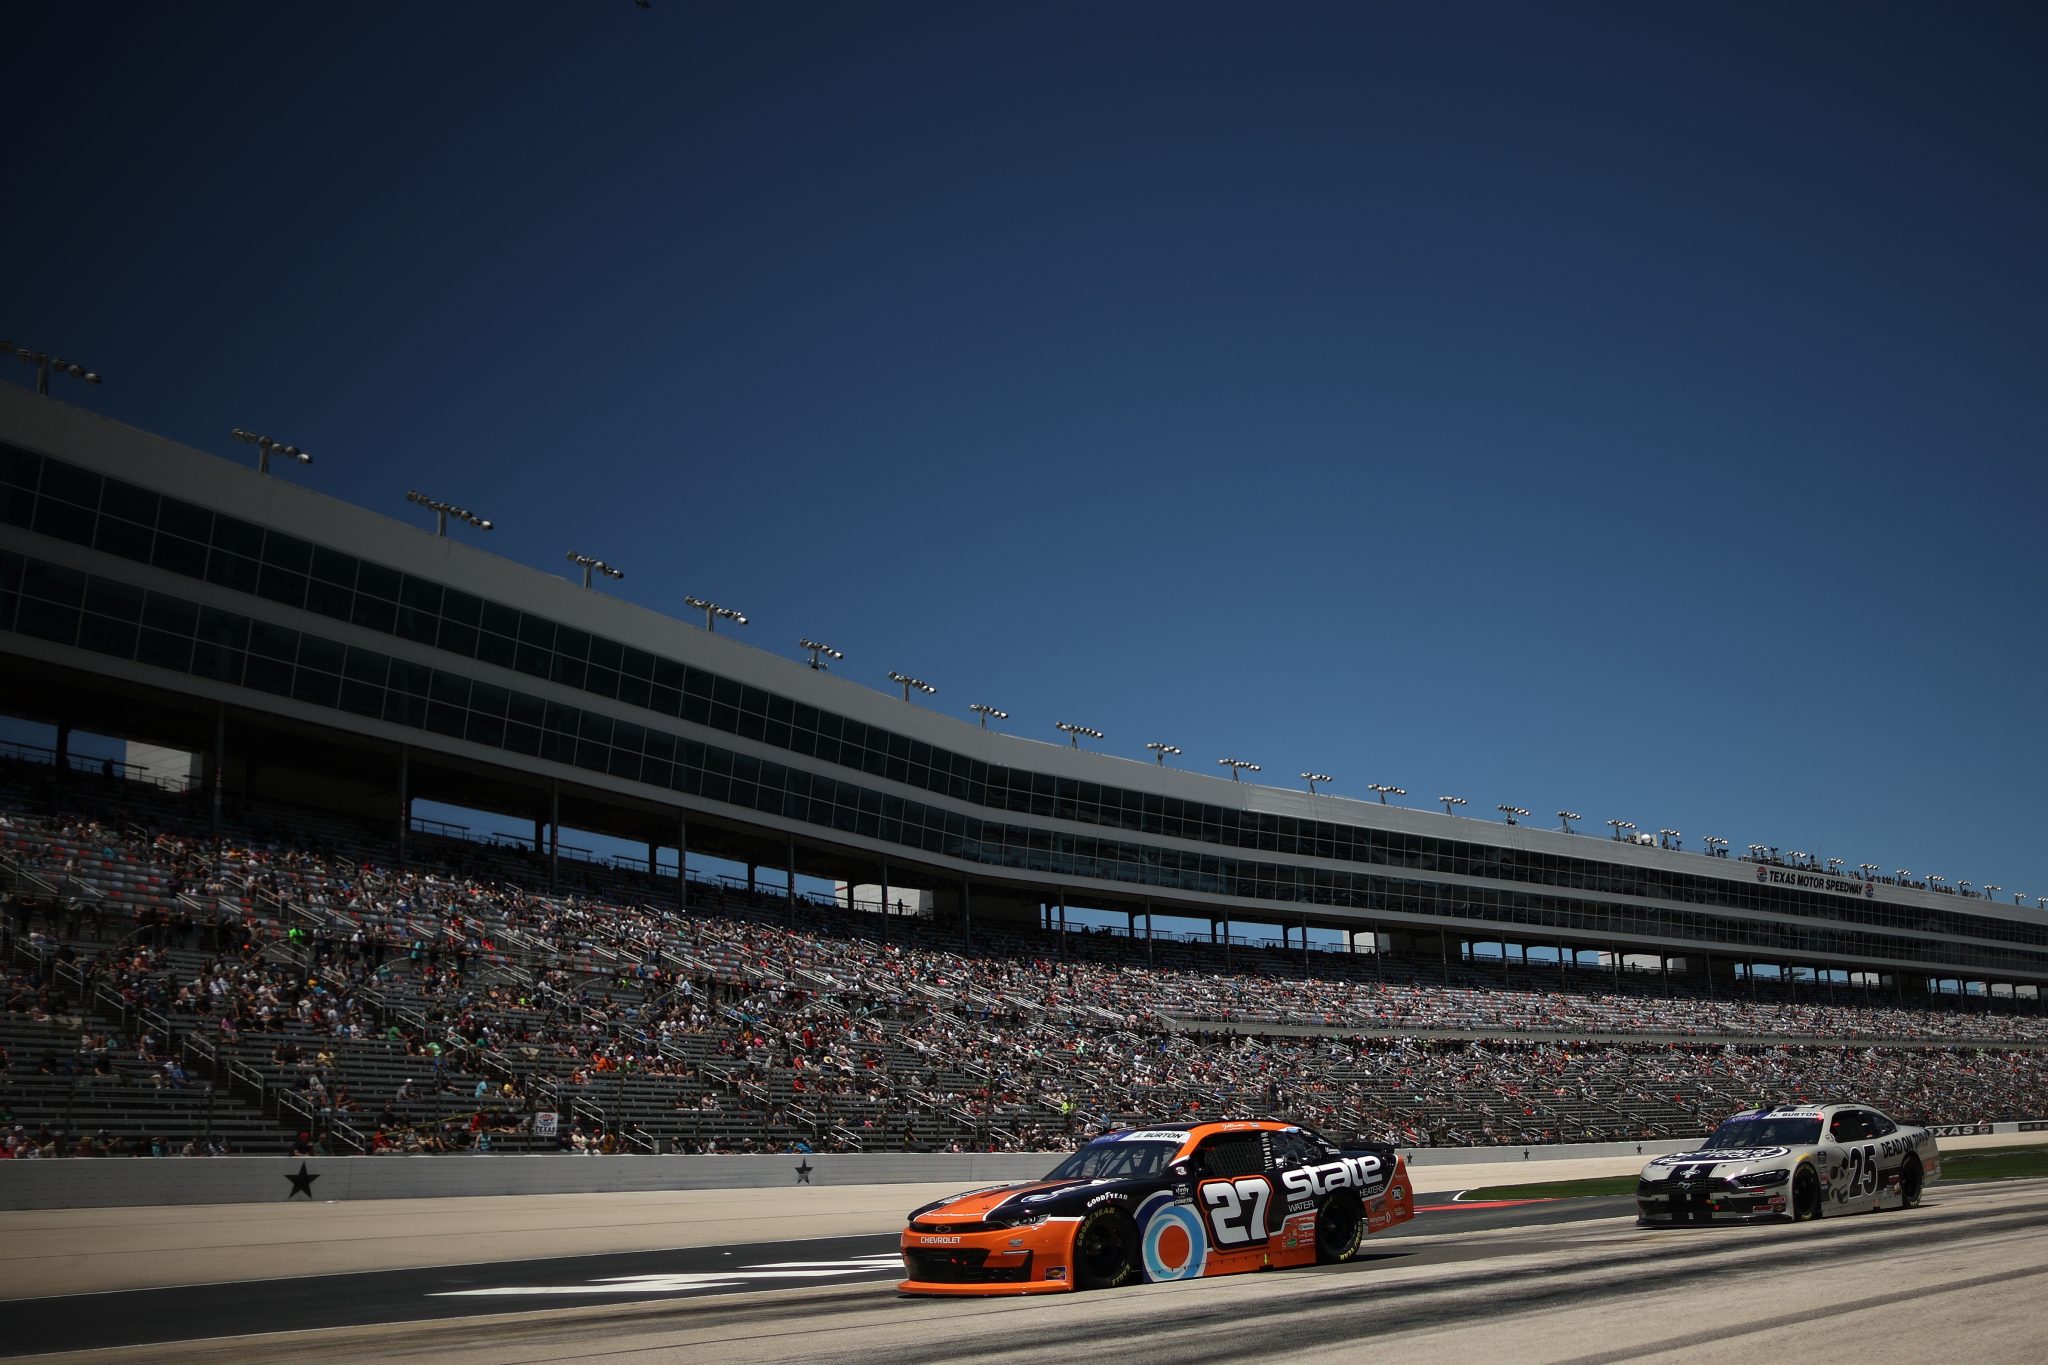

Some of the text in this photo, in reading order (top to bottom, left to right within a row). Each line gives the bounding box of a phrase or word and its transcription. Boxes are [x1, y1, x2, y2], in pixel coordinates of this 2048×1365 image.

[1769, 871, 1863, 895] TEXAS MOTOR SPEEDWAY
[535, 1125, 556, 1133] TEXAS
[1934, 1126, 1974, 1136] XAS
[1880, 1139, 1903, 1158] DEAD
[1901, 1134, 1914, 1152] ON
[1282, 1155, 1383, 1202] state
[1849, 1144, 1877, 1199] 25
[1087, 1191, 1128, 1208] GOODYEAR
[1359, 1184, 1384, 1198] HEATERS
[1202, 1178, 1270, 1244] 27
[1288, 1199, 1315, 1213] WATER
[1077, 1207, 1115, 1247] GOODYEAR
[920, 1236, 962, 1244] CHEVROLET
[1111, 1264, 1131, 1286] EAGLE
